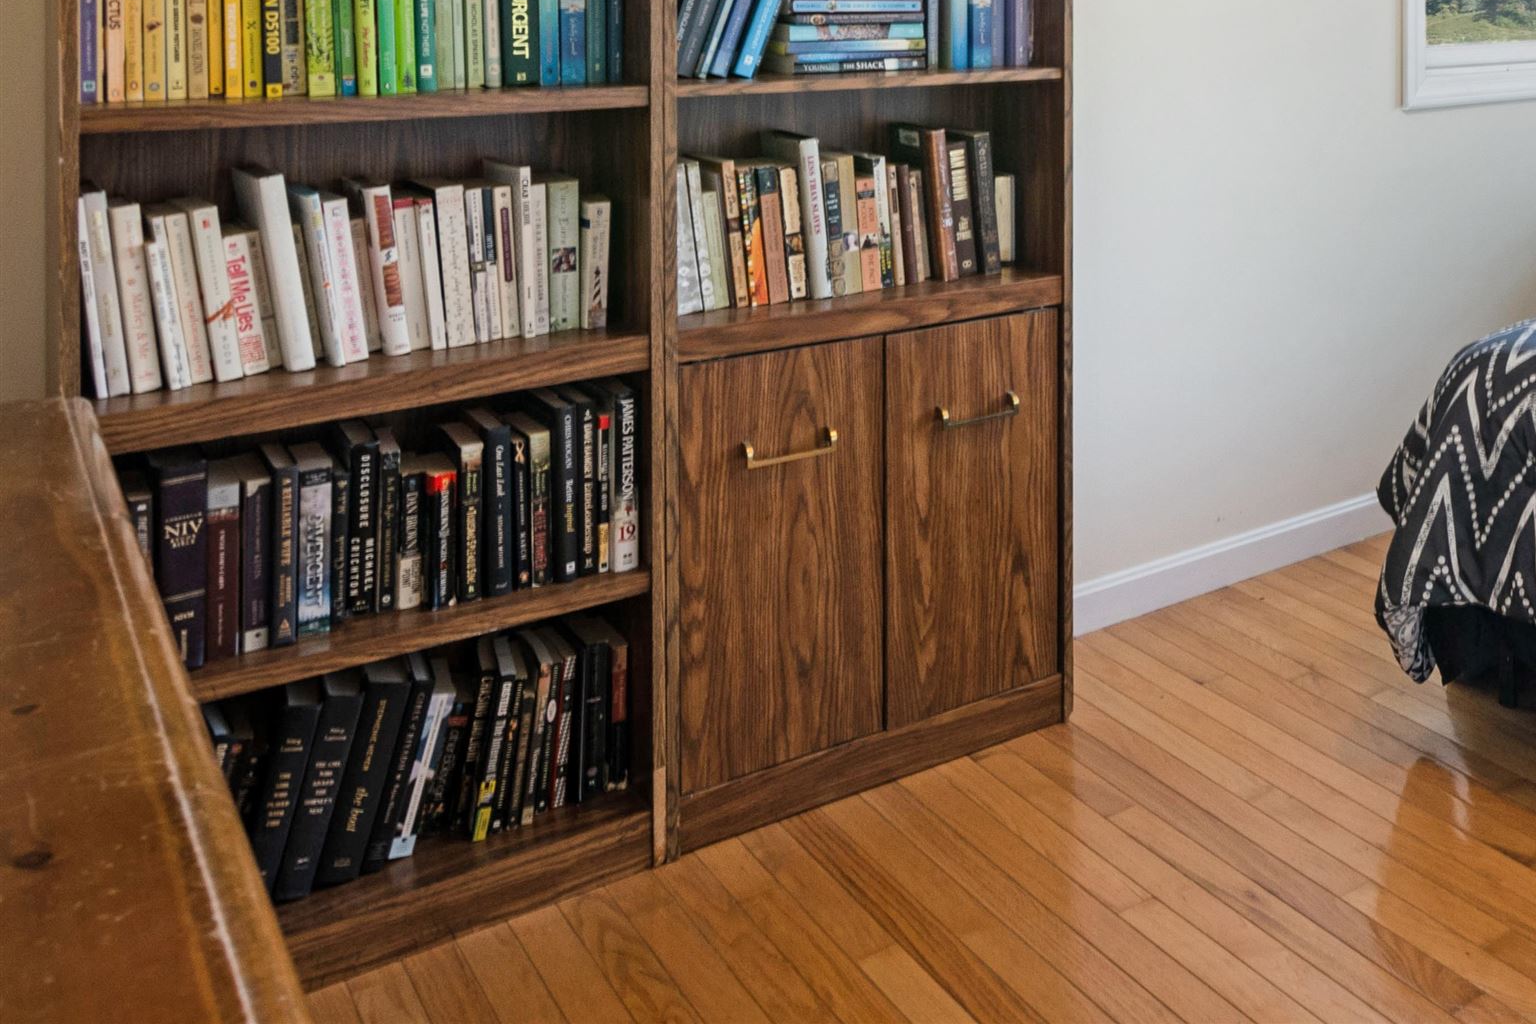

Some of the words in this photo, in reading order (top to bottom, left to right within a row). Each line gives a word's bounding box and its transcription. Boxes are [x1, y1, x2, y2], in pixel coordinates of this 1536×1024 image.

[265, 10, 280, 55] D5100
[855, 60, 884, 69] SHACK
[807, 155, 816, 178] LESS
[809, 179, 818, 202] THAN
[812, 203, 822, 235] SLAVES
[226, 255, 248, 277] Tell
[231, 278, 250, 302] Me
[235, 303, 254, 333] Lies
[620, 398, 634, 434] JAMES
[584, 423, 593, 445] DAVE
[584, 446, 594, 478] RAMSEY
[621, 435, 635, 500] PATTERSON
[359, 454, 370, 528] DISCLOSURE
[406, 491, 417, 514] DAN
[164, 518, 203, 539] NIV
[406, 515, 418, 550] BROWN
[584, 482, 594, 554] EntreLeadership
[306, 515, 324, 608] DIVERGENT
[350, 537, 360, 597] CRICHTON
[363, 537, 374, 592] MICHAEL
[353, 787, 368, 806] the
